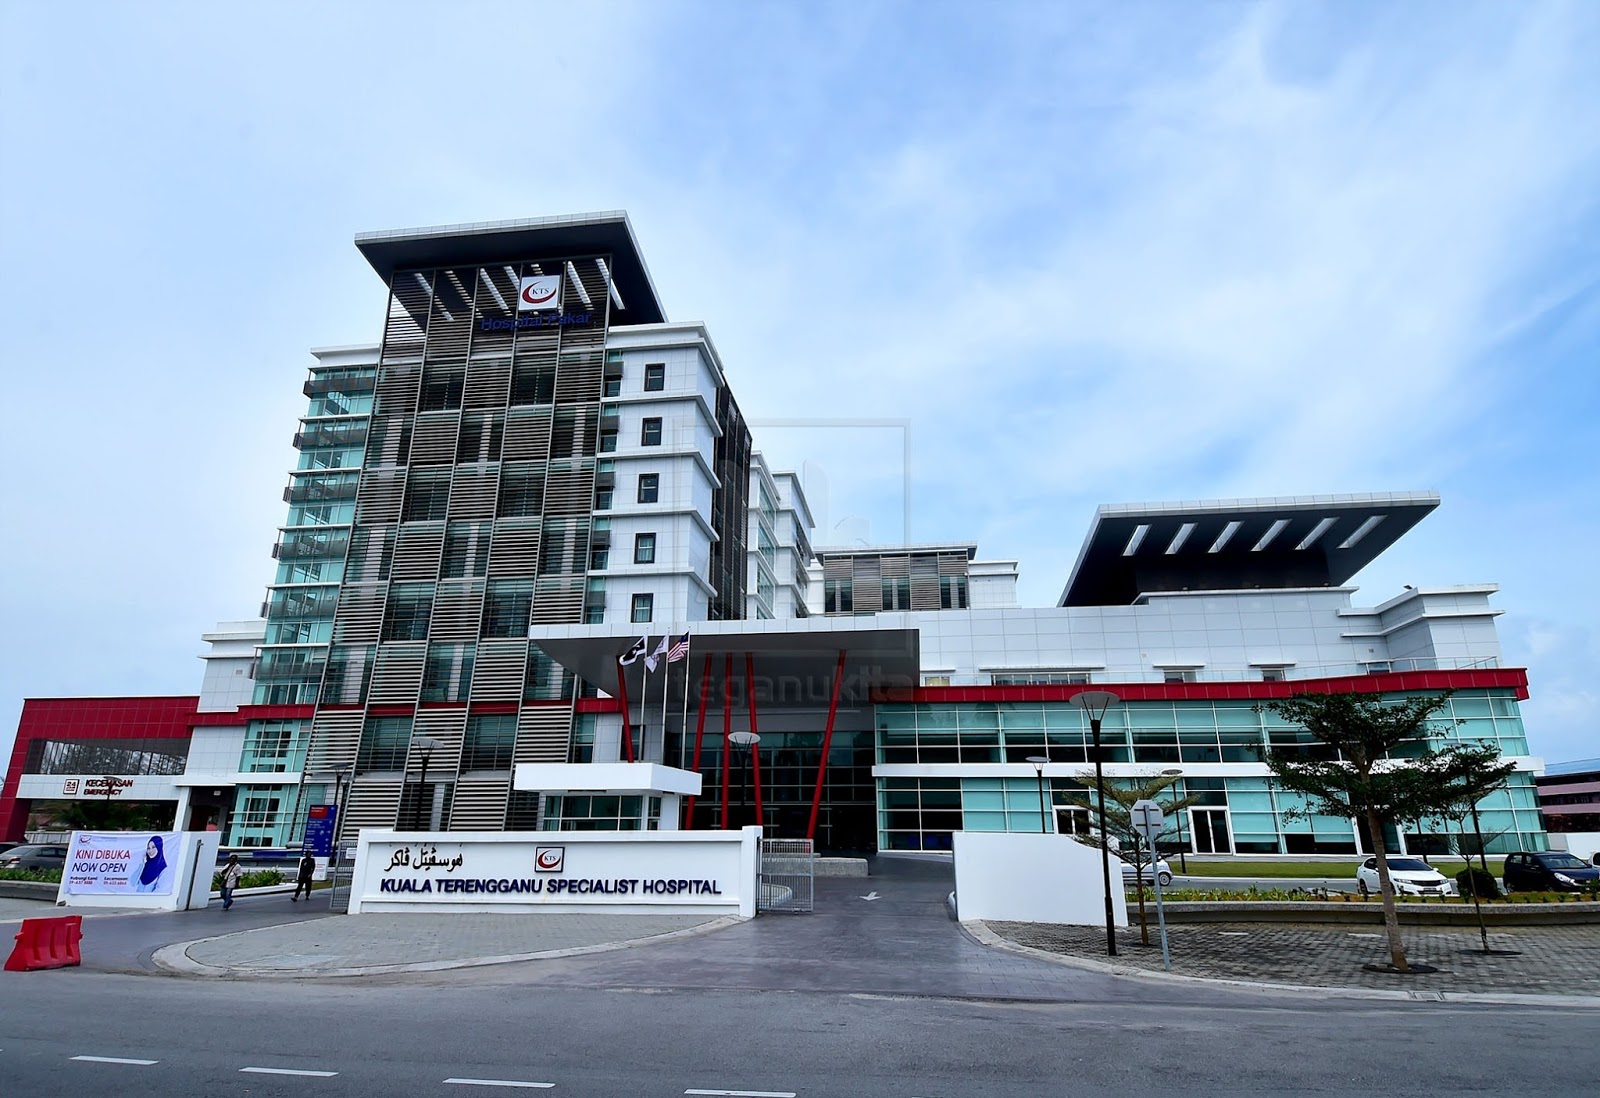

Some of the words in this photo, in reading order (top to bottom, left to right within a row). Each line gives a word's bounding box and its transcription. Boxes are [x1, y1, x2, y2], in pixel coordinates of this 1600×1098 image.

[481, 315, 543, 330] Hospital
[75, 849, 94, 860] KINI
[96, 850, 130, 860] DIBUKA
[72, 862, 98, 873] NOW
[100, 862, 127, 872] OPEN
[380, 878, 432, 893] KUALA
[434, 878, 543, 894] TERENGGANU
[546, 879, 638, 894] SPECIALIST
[642, 879, 722, 895] HOSPITAL
